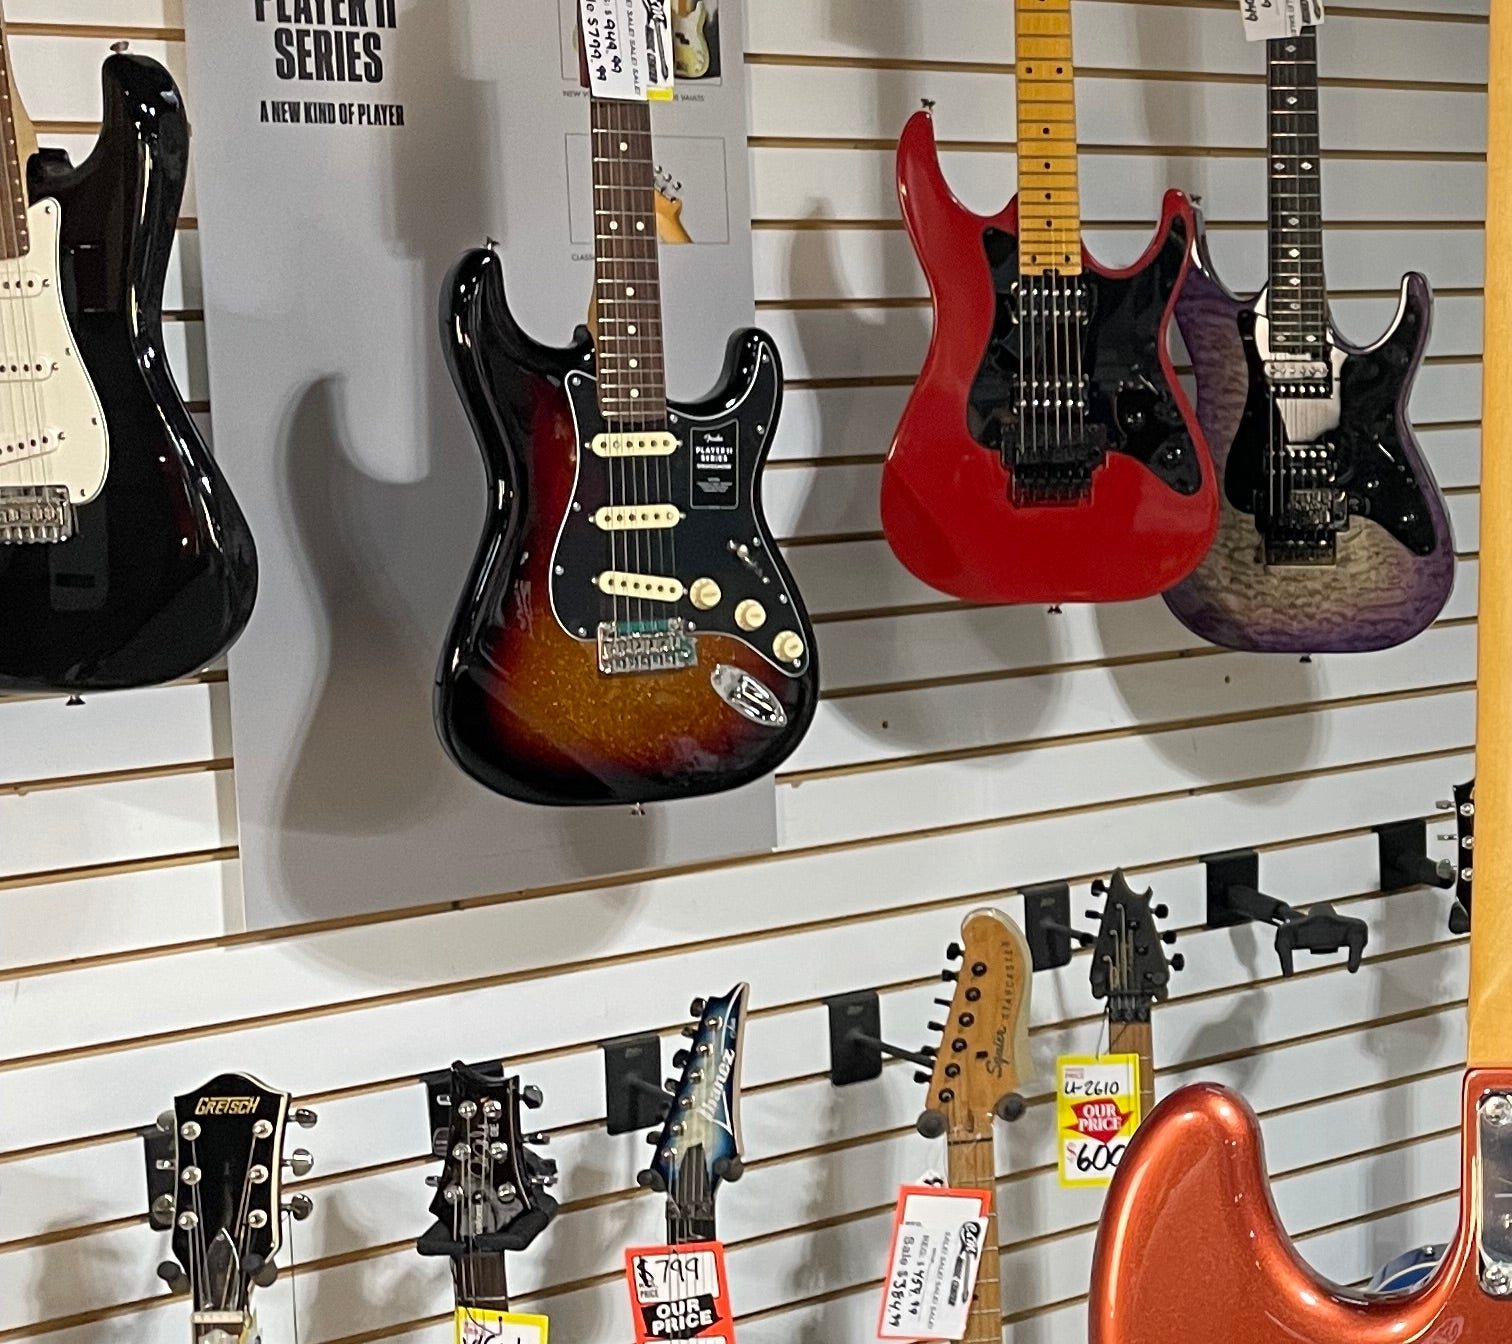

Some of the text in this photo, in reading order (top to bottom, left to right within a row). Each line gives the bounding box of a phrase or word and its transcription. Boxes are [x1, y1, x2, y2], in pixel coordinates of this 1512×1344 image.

[274, 27, 383, 83] SERIES
[260, 100, 404, 126] A NEW KIND OF PLAYER
[986, 1025, 1009, 1080] Squier
[697, 1049, 735, 1121] Ibanez
[1065, 1080, 1119, 1096] U-2610
[194, 1096, 260, 1115] GRETSCH
[1082, 1103, 1116, 1117] OUR
[1078, 1117, 1122, 1132] PRICE
[900, 1236, 914, 1266] Sale
[640, 1289, 659, 1298] PRICE
[656, 1299, 700, 1319] OUR
[652, 1309, 713, 1336] PRICE
